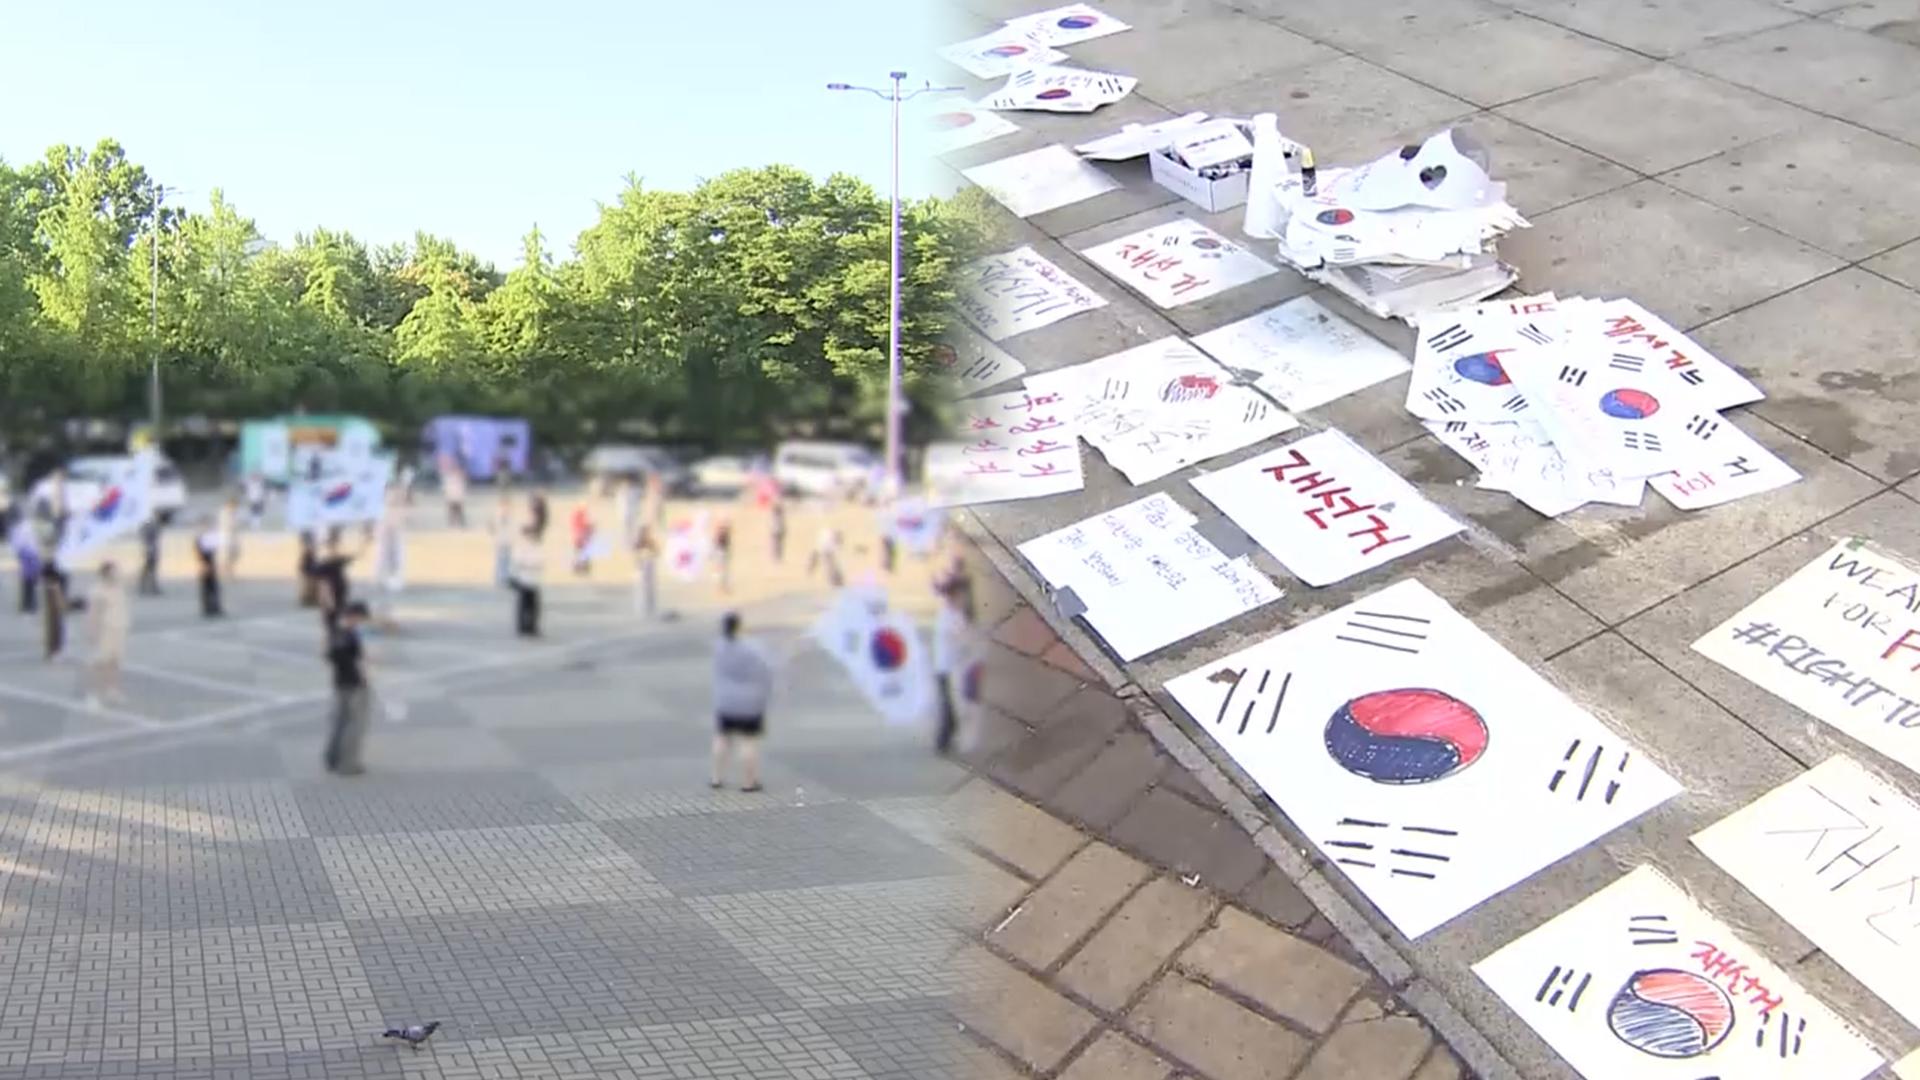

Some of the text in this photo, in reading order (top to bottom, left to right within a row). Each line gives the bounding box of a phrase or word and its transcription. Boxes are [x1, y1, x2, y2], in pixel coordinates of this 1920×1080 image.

[1118, 243, 1210, 296] 재선거
[1262, 448, 1411, 555] 재선거
[1690, 940, 1784, 1015] 재선거
